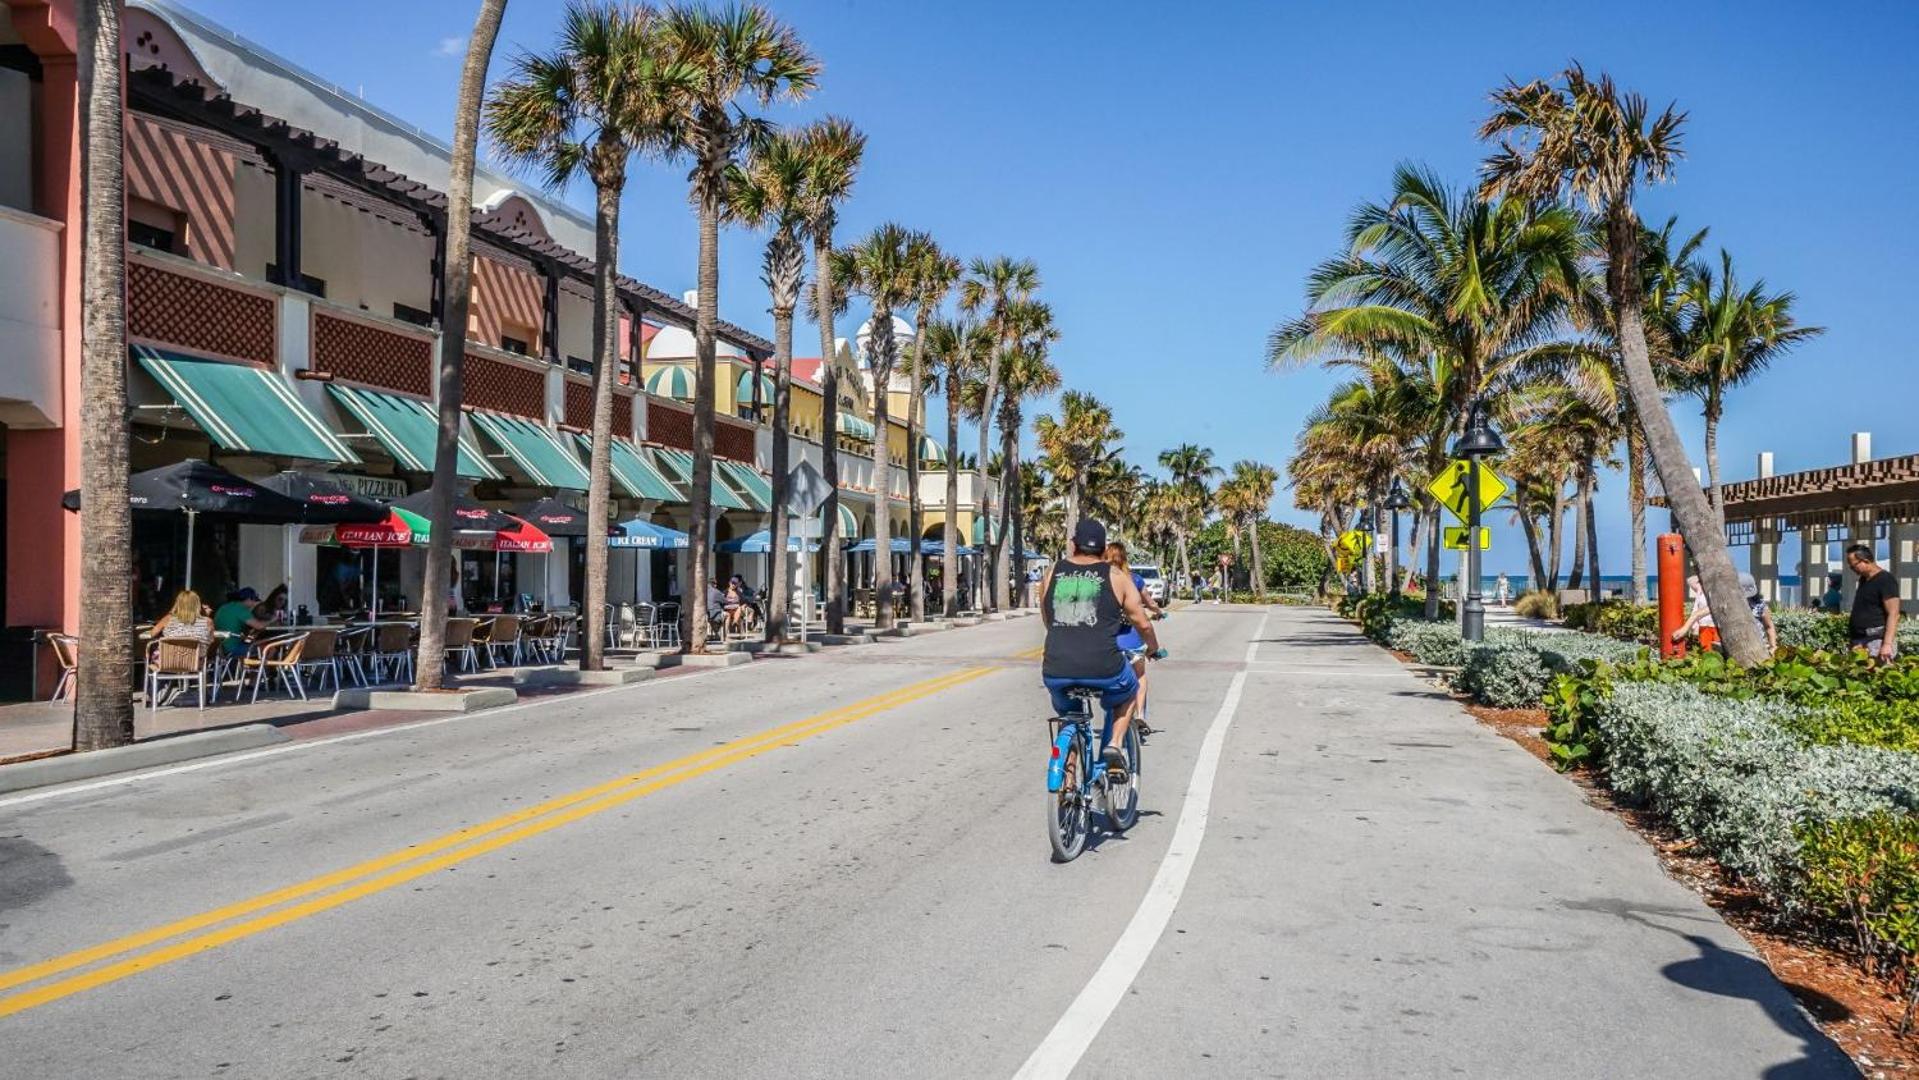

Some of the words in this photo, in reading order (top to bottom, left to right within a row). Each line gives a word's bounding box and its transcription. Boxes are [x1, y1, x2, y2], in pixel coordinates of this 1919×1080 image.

[357, 479, 407, 498] PIZZERIA
[341, 531, 383, 542] ITALIAN
[617, 537, 629, 545] ICE
[631, 536, 657, 546] CREAM
